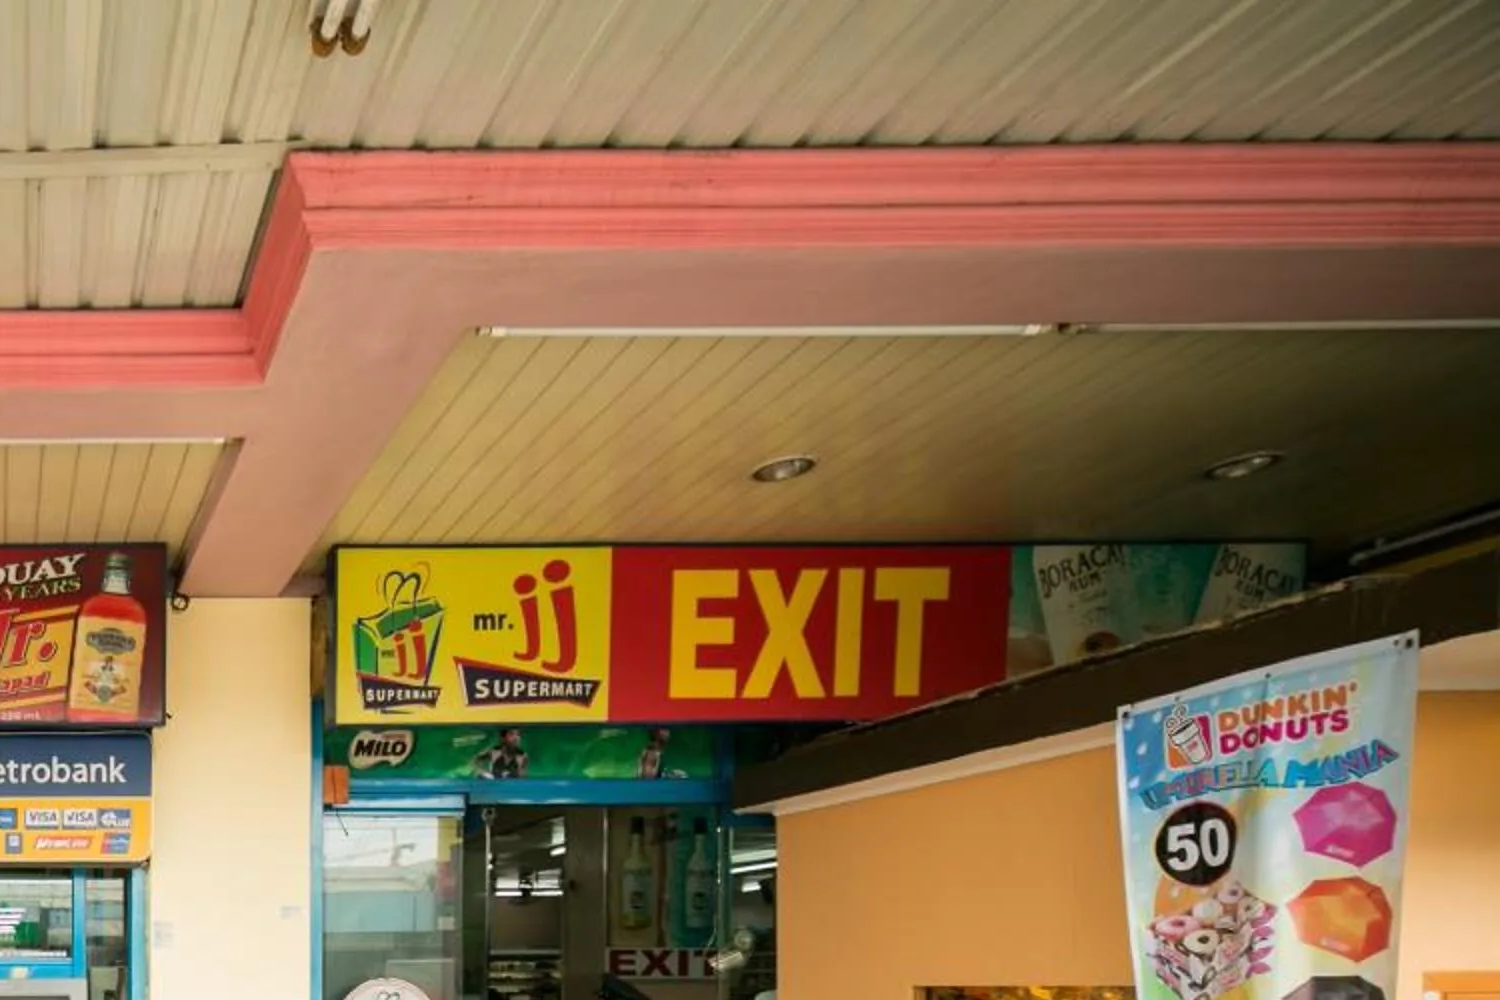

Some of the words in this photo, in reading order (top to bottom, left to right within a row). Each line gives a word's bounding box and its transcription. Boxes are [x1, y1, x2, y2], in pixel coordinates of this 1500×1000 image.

[5, 577, 82, 601] YEARS
[472, 612, 514, 631] mr.
[668, 566, 950, 698] EXIT
[366, 687, 440, 702] SUPERMART
[474, 678, 594, 700] SUPERMART
[1217, 682, 1358, 733] DUNKIN'
[1219, 709, 1349, 755] DONUTS
[352, 738, 408, 758] MILO
[29, 810, 58, 822] VISA
[65, 810, 95, 823] VISA
[1166, 817, 1231, 872] 50
